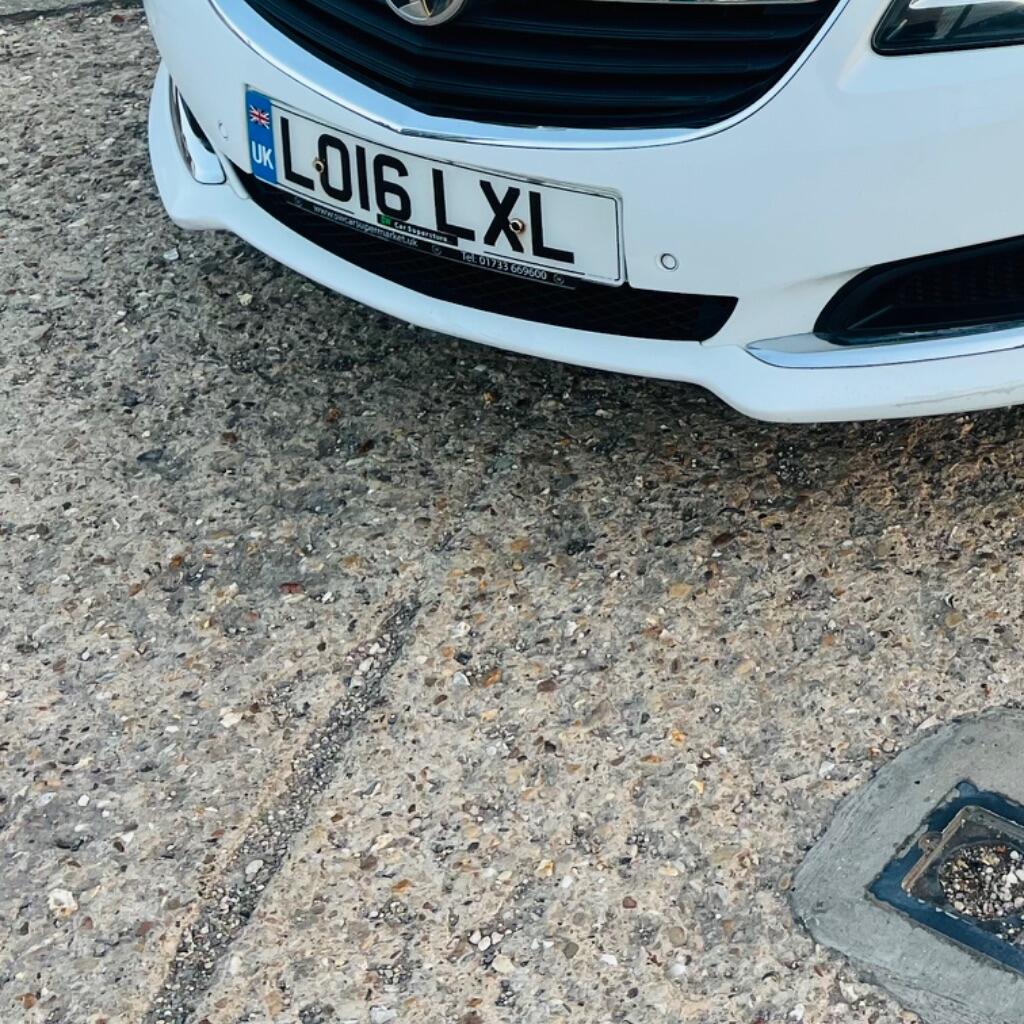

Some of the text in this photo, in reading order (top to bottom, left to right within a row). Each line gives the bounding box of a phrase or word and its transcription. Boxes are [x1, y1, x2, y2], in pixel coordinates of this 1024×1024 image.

[250, 140, 275, 170] UK
[280, 116, 575, 264] LO16 LXL
[479, 256, 509, 272] 01733
